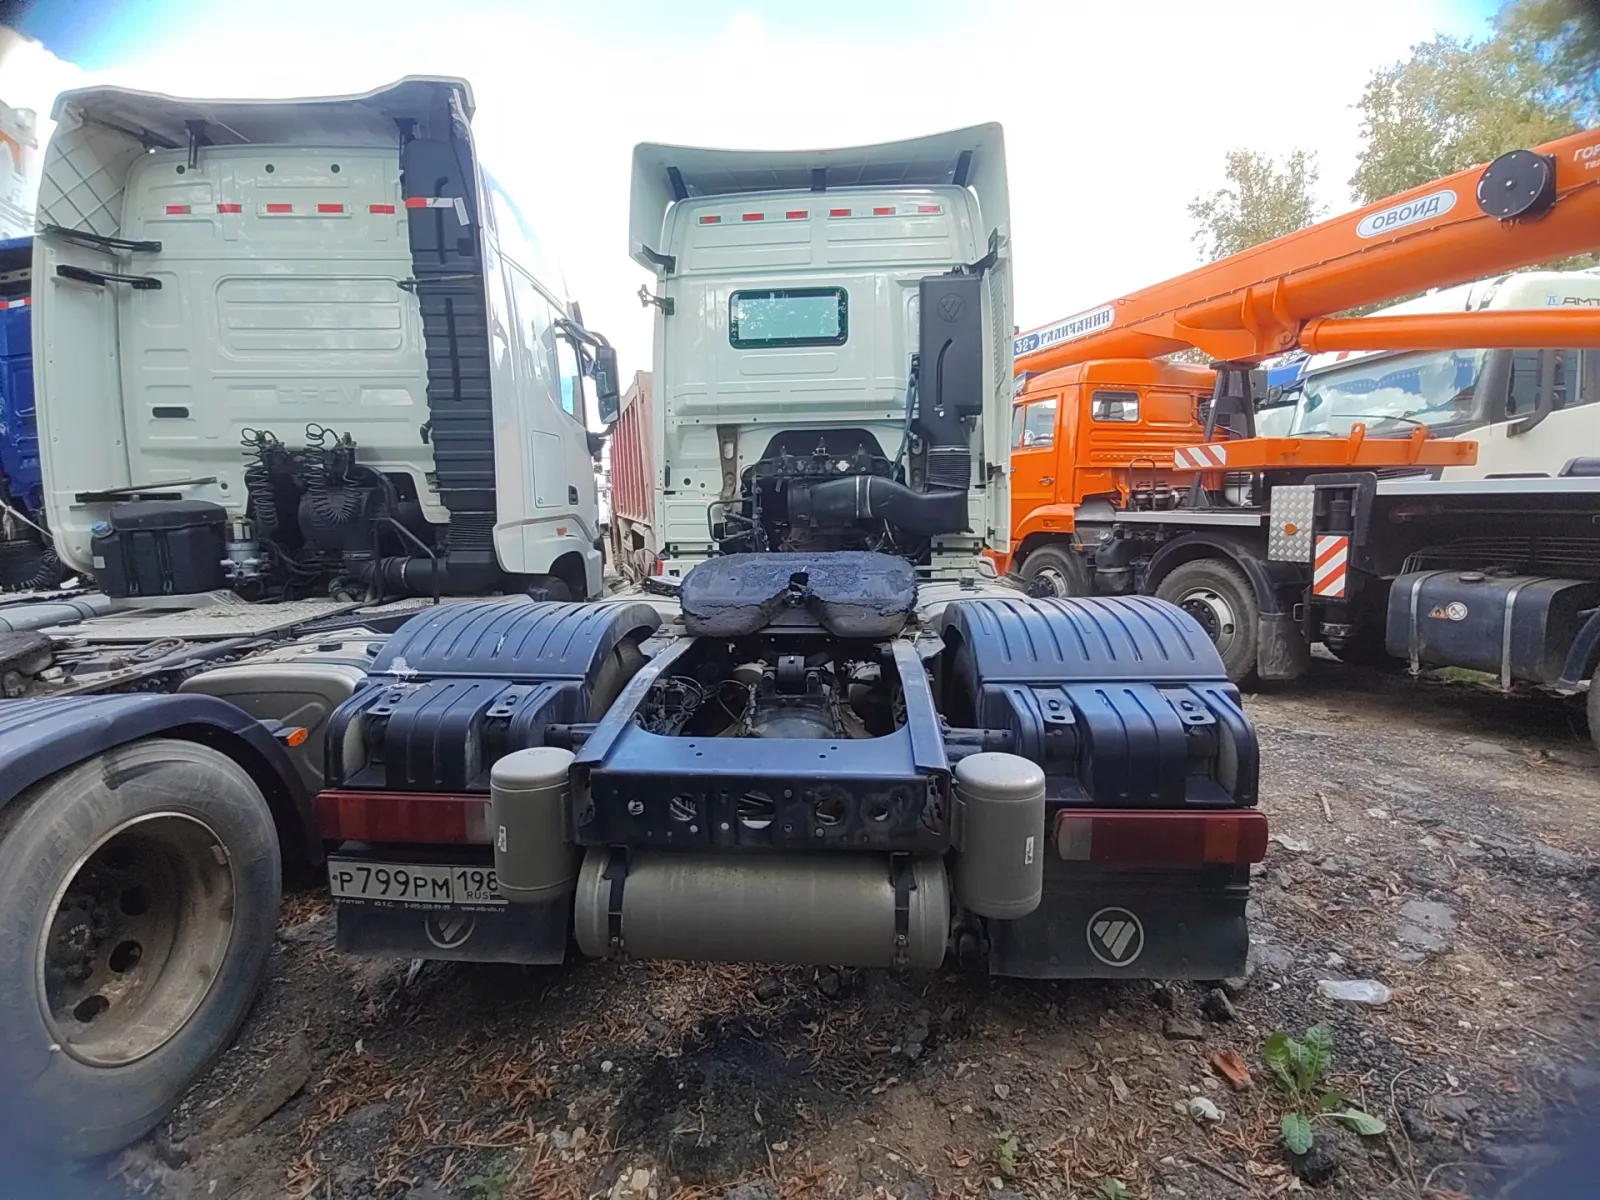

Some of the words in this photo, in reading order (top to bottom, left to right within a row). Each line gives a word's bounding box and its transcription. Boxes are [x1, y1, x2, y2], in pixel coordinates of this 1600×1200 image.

[1372, 196, 1440, 230] ОВОИД
[1041, 309, 1110, 345] ГАЛИЧАНИН
[456, 871, 499, 892] 198
[466, 890, 489, 900] RUS
